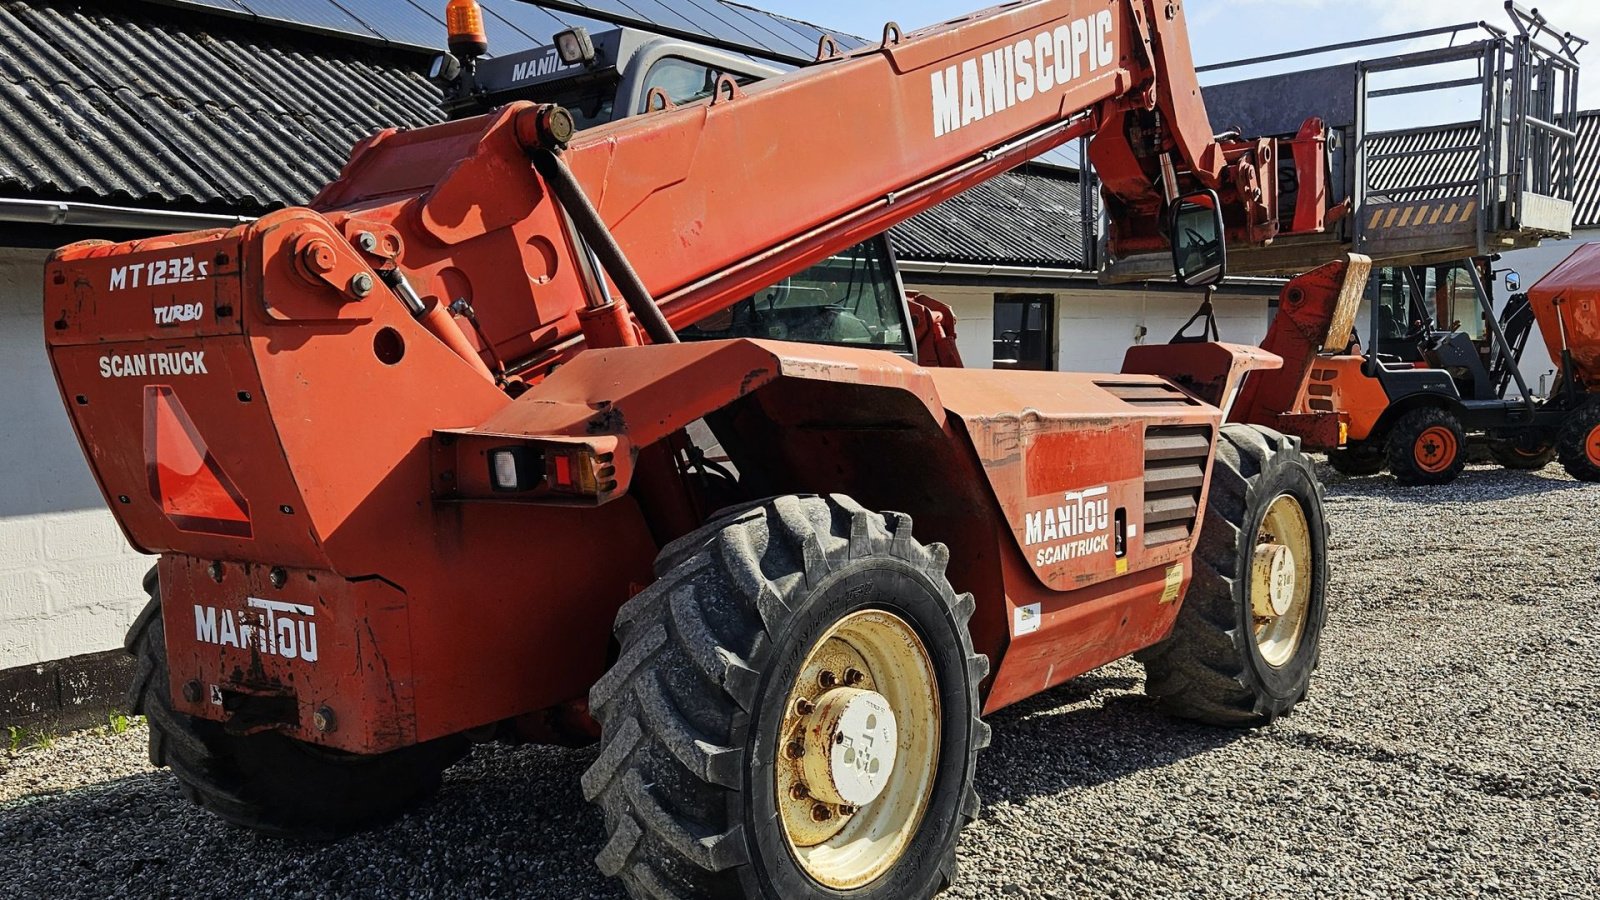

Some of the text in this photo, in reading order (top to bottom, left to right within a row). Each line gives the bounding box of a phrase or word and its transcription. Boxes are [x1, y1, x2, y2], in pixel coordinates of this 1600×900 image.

[931, 9, 1113, 138] MANISCOPIC
[153, 302, 203, 324] TURBO
[99, 351, 208, 377] SCANTRUCK
[1025, 486, 1108, 546] MANITOU
[1036, 534, 1109, 567] SCANTRUCK
